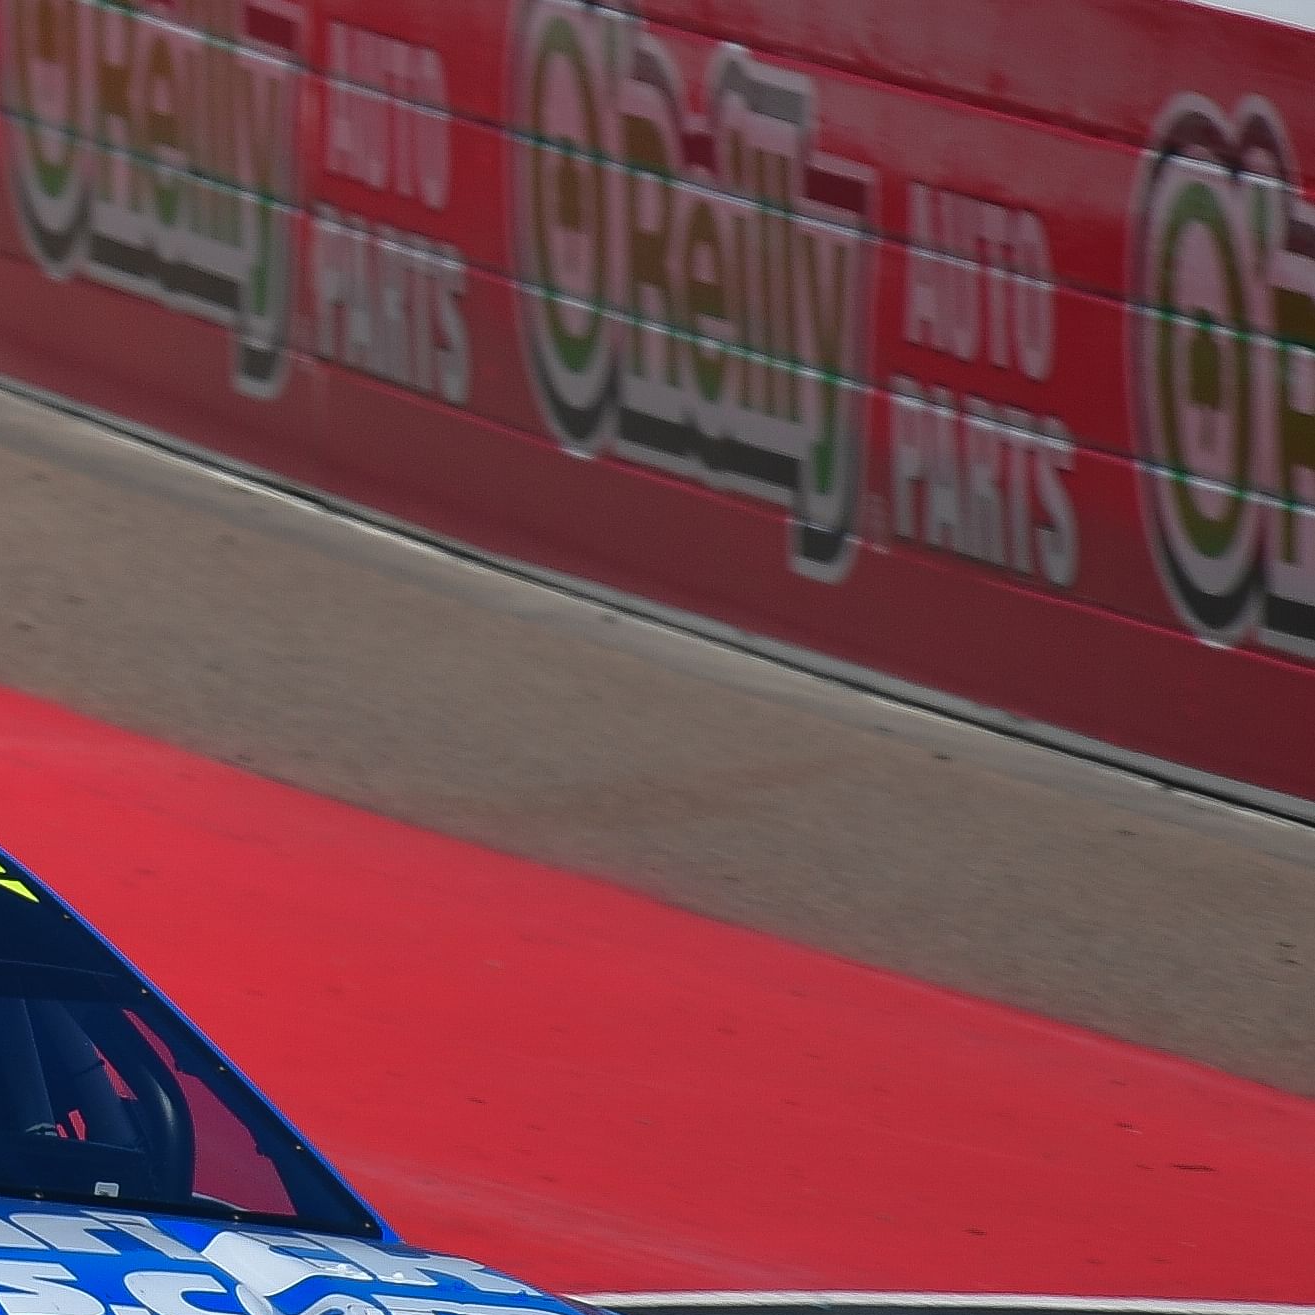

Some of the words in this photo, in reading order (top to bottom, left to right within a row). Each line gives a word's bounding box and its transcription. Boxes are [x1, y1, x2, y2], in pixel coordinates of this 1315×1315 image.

[325, 18, 450, 212] AUTO
[314, 200, 468, 410] PARTS
[903, 180, 1055, 384] AUTO
[889, 374, 1079, 588] PARTS
